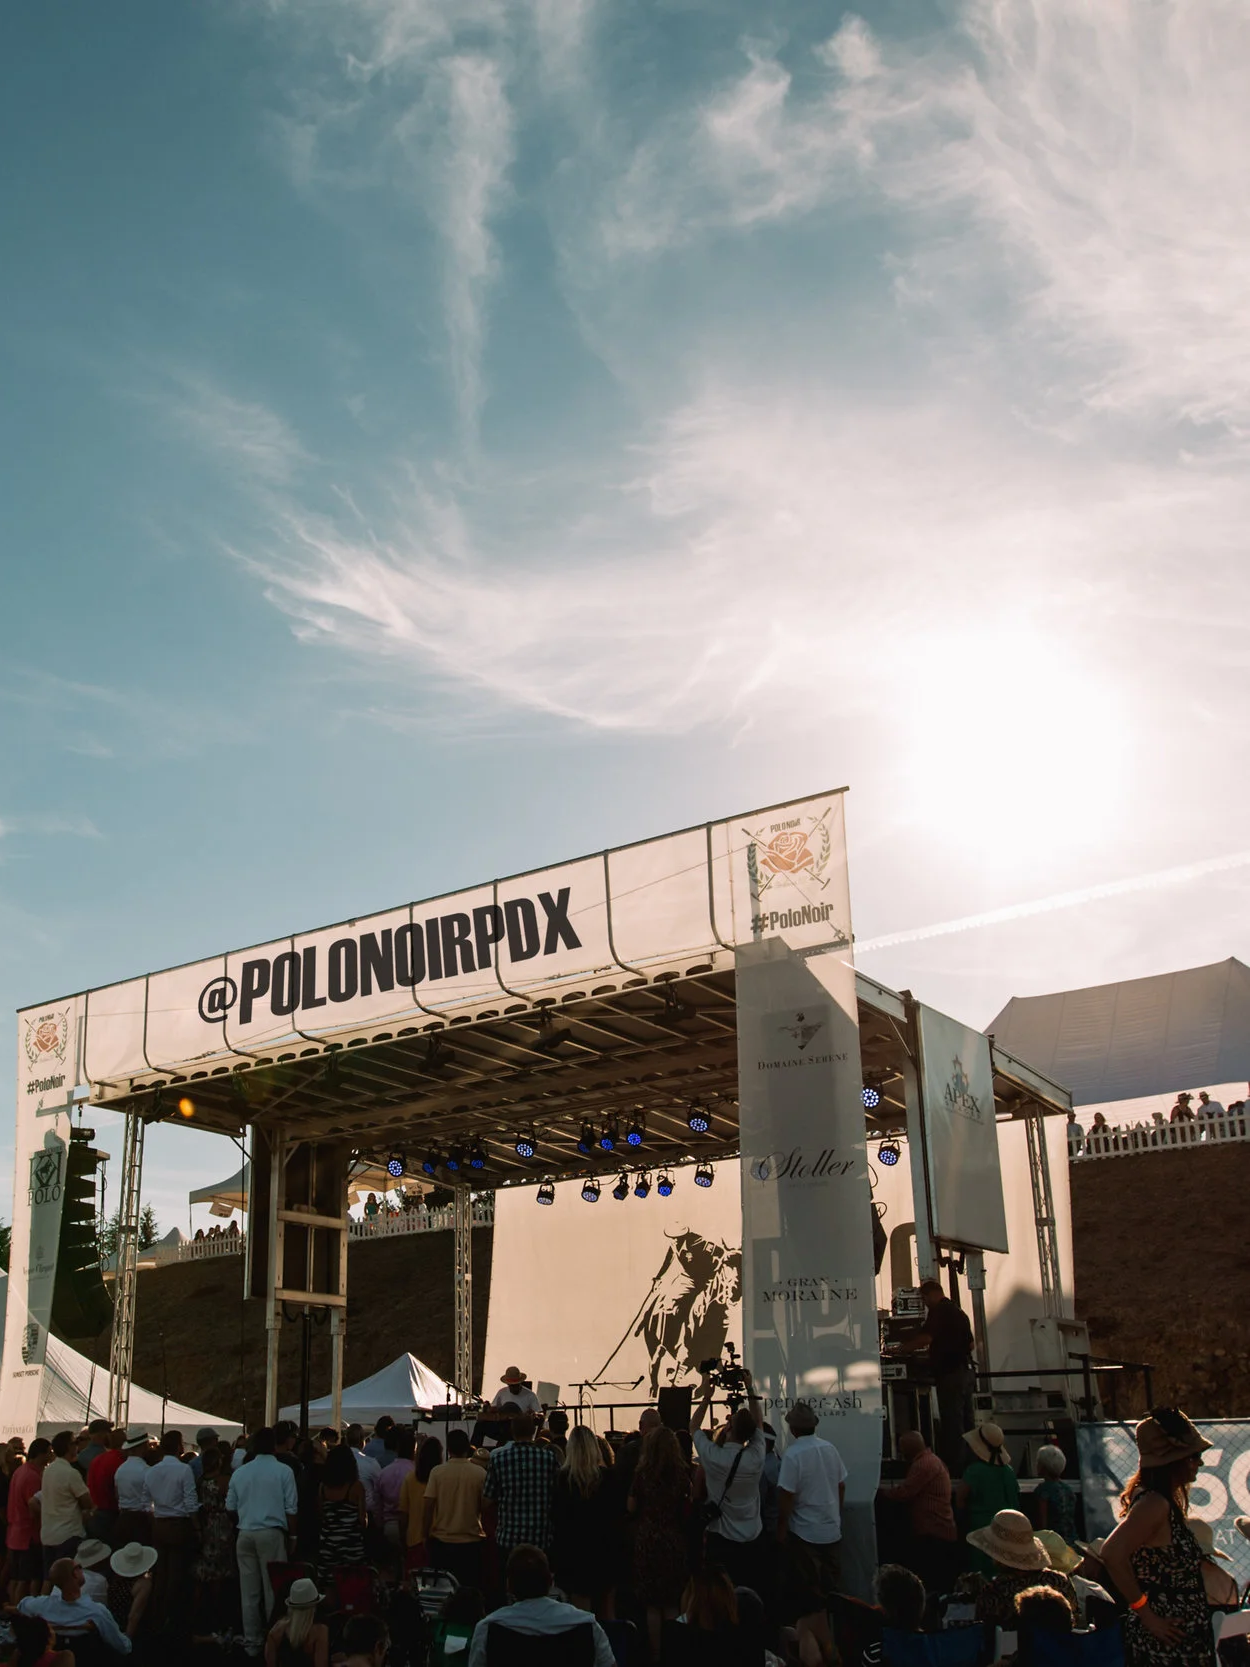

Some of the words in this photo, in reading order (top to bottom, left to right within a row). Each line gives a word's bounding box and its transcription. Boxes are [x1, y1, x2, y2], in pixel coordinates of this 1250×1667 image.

[750, 902, 833, 933] #PoloNoir
[197, 887, 582, 1024] @POLONOIRPDX
[27, 1073, 66, 1095] #PoloNoir
[944, 1082, 981, 1113] APEX
[758, 1146, 855, 1181] Stoller
[27, 1185, 61, 1207] POLO
[762, 1288, 858, 1302] MORAINE
[787, 1277, 830, 1287] GRAN
